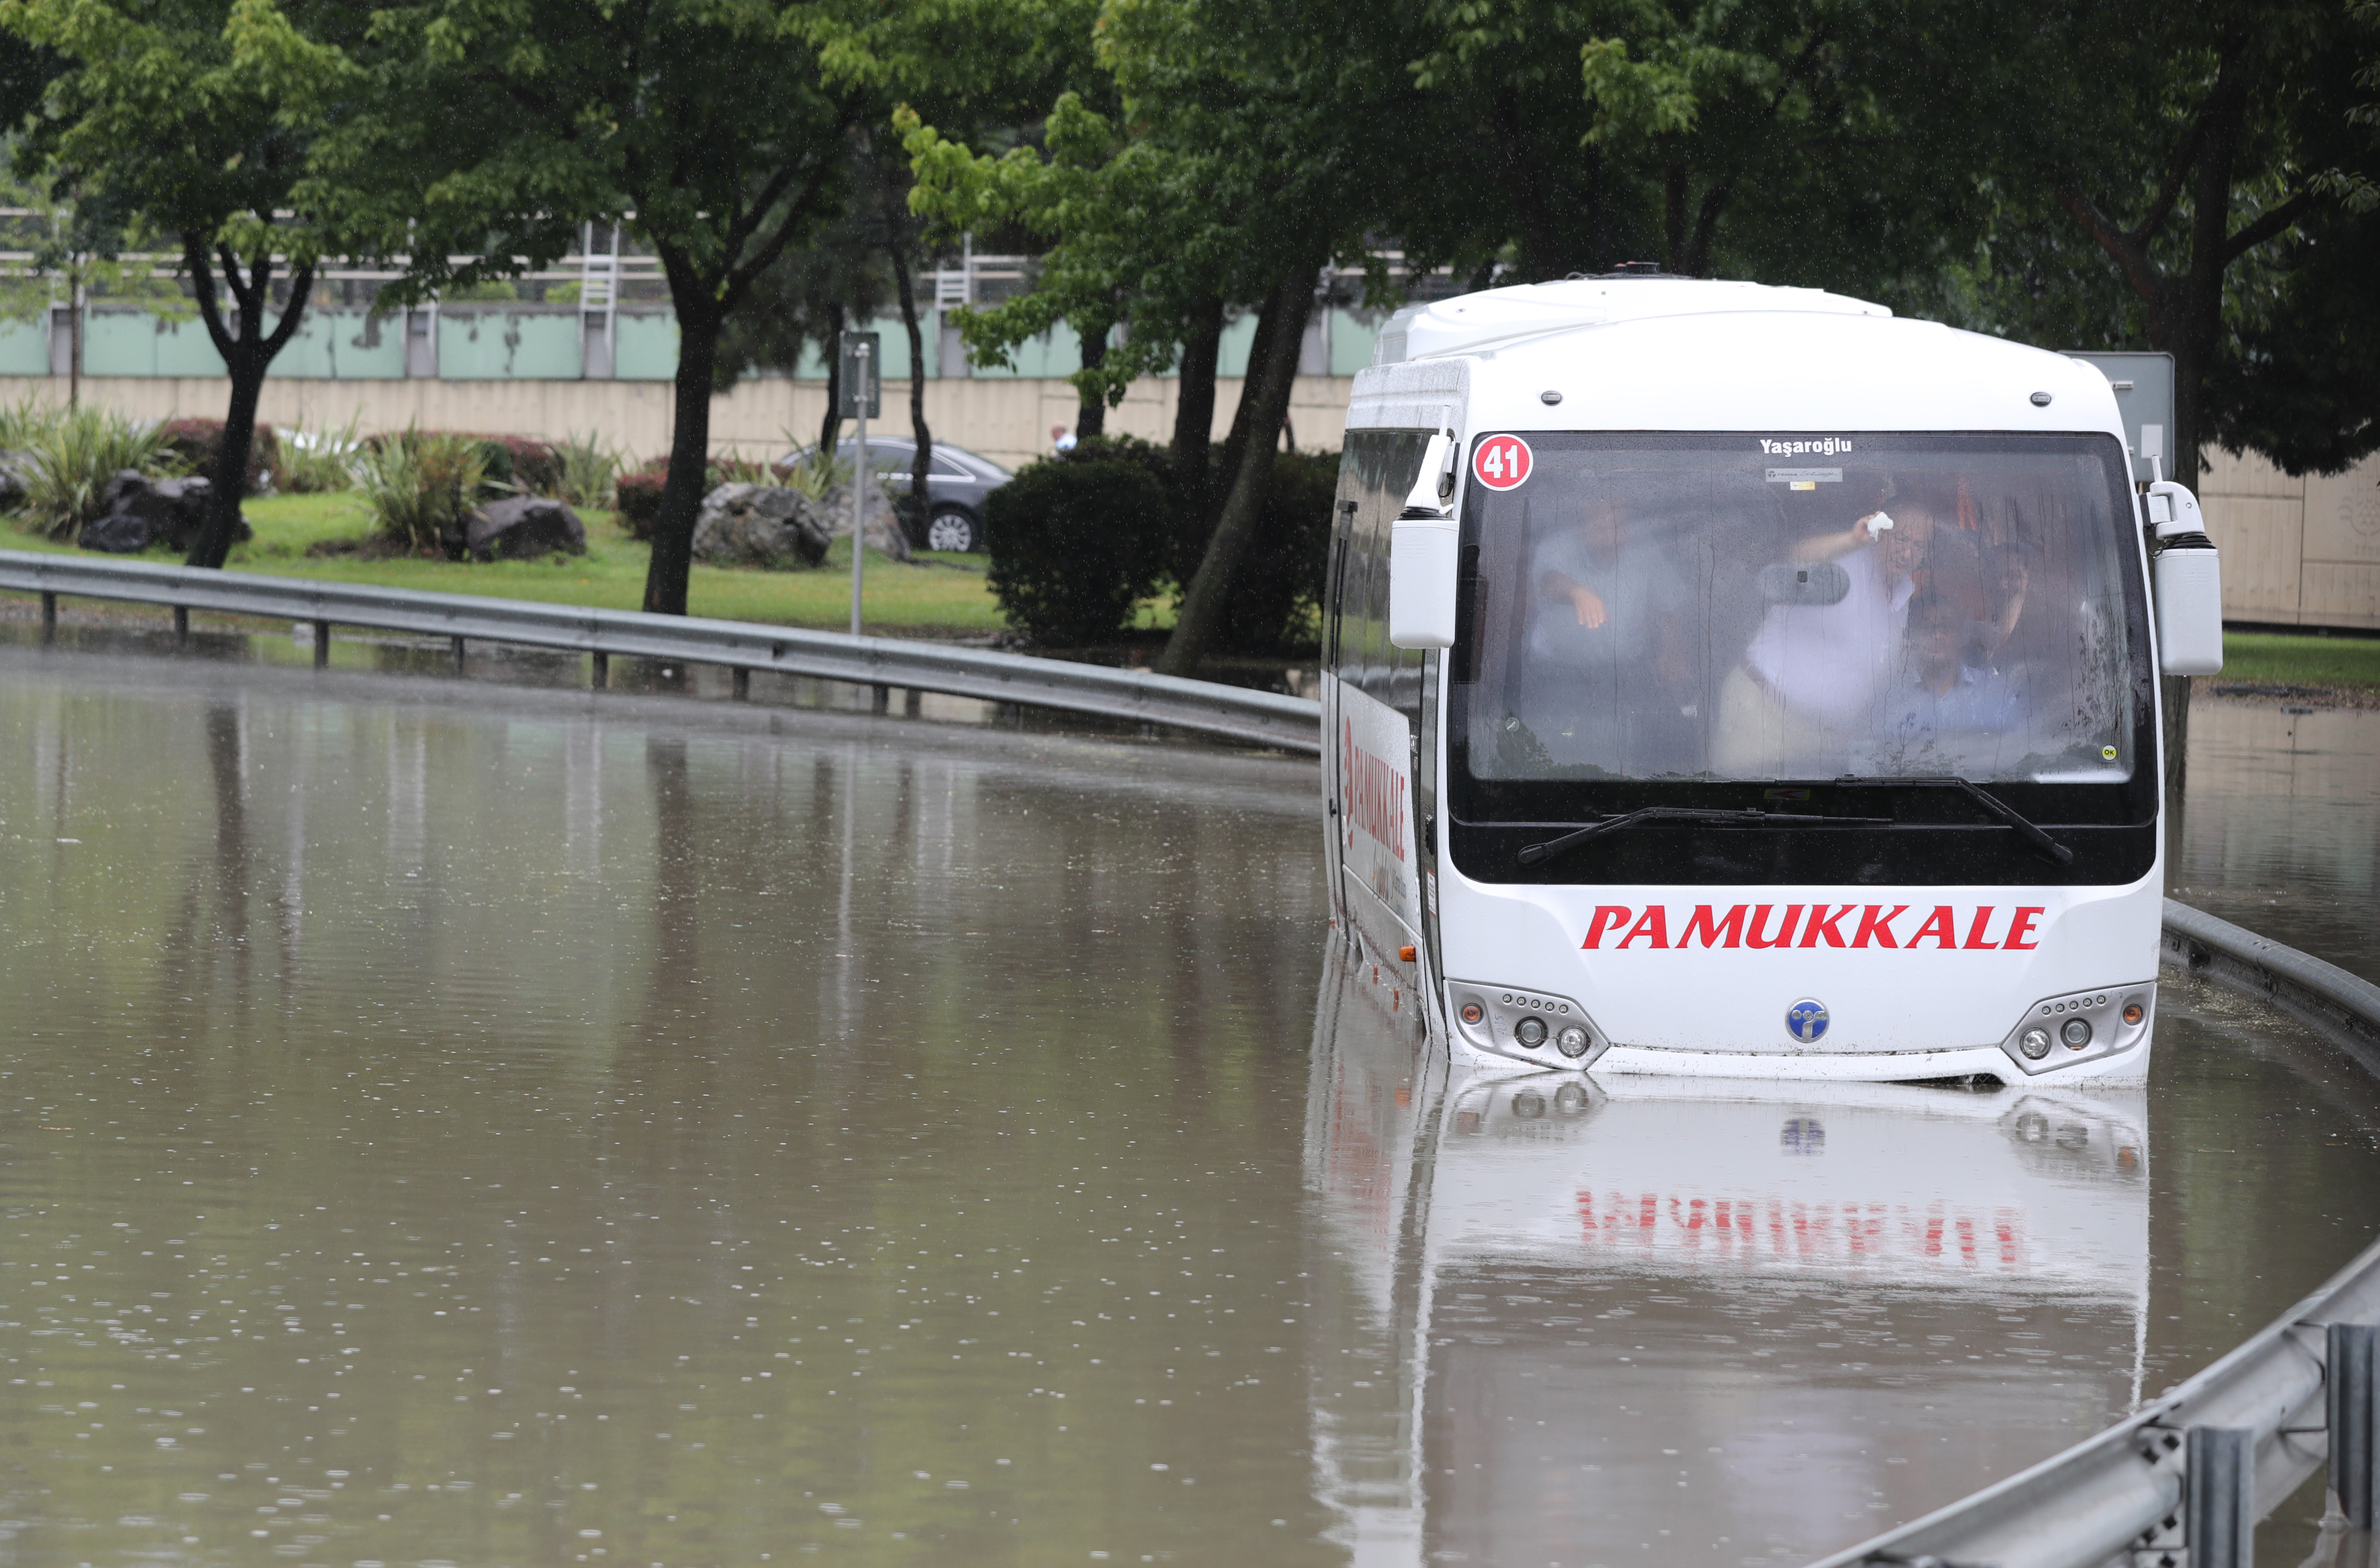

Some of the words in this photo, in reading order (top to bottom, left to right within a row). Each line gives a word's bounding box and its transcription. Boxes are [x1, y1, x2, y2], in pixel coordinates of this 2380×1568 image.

[1483, 444, 1518, 479] 41
[1760, 437, 1852, 457] Yaşaroğlu
[1354, 745, 1405, 862] PAMUKKALE
[1579, 904, 2046, 950] PAMUKKALE
